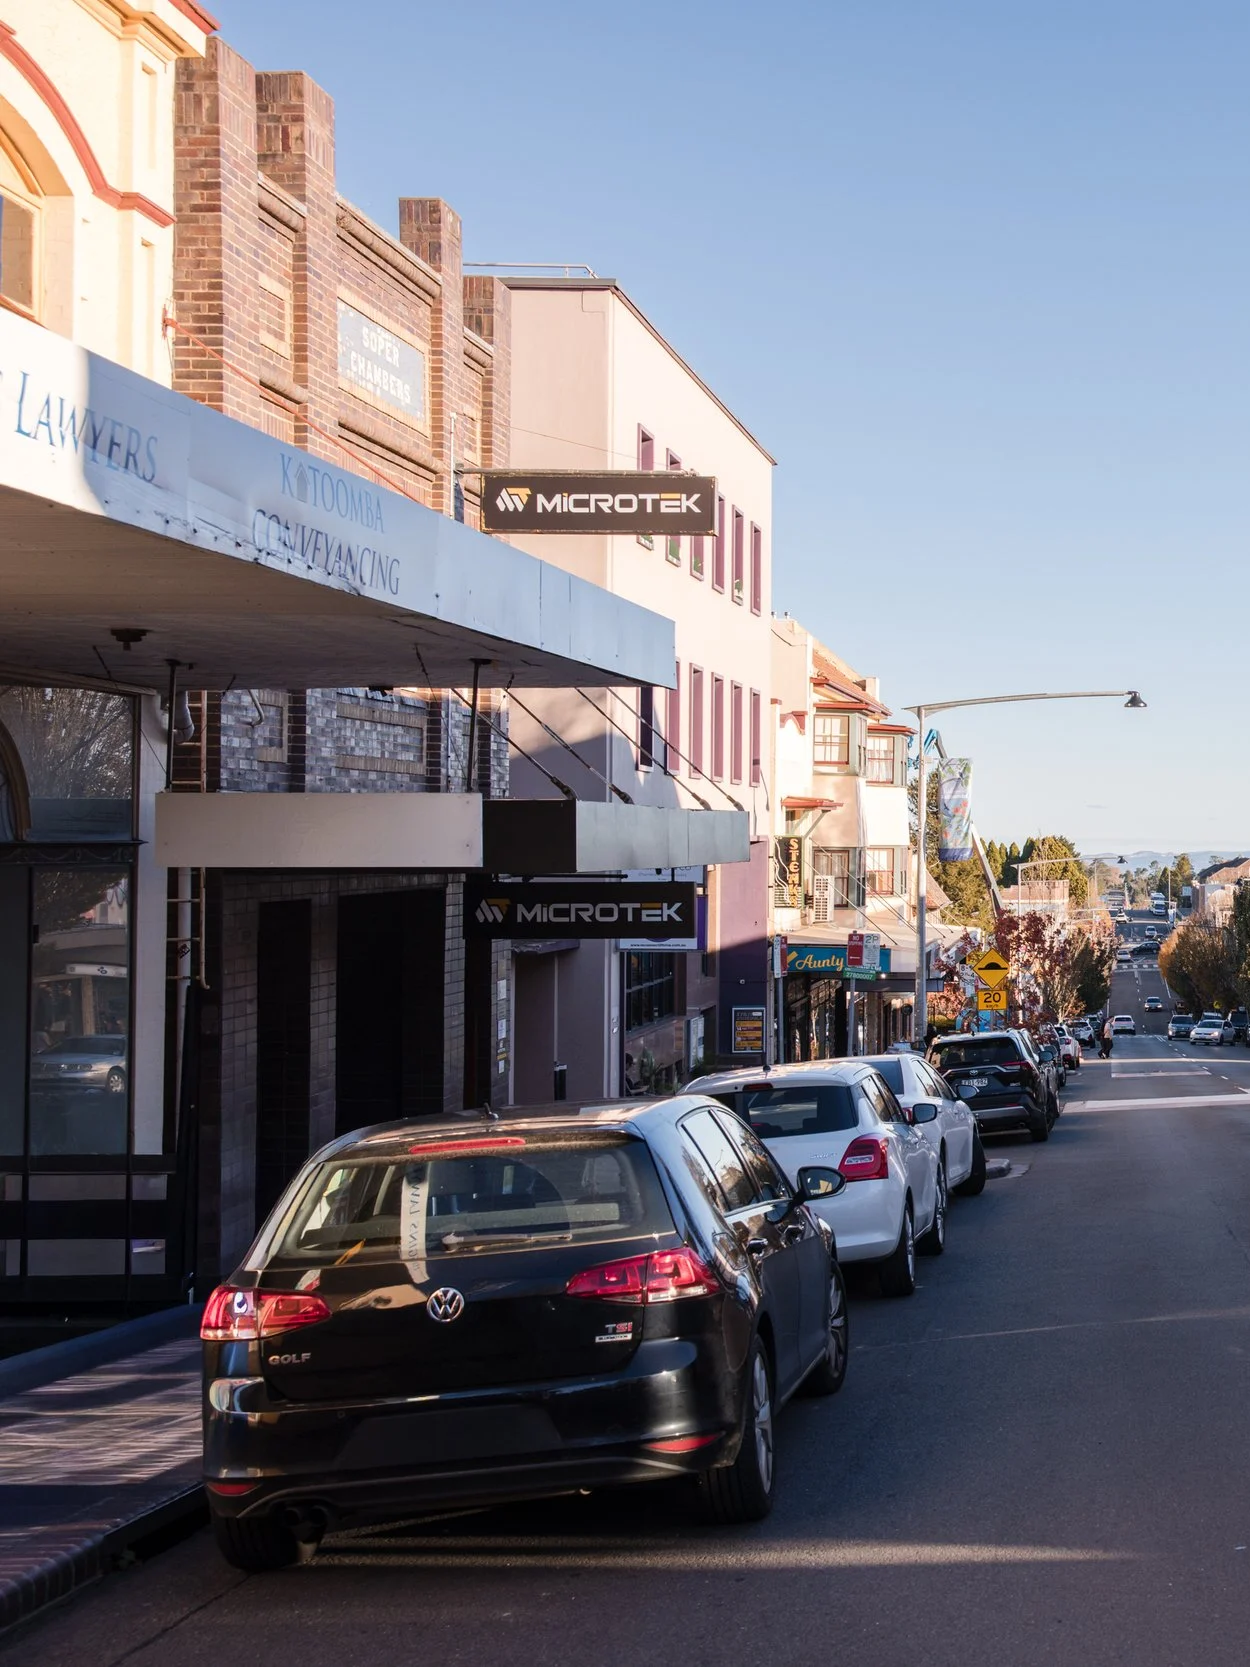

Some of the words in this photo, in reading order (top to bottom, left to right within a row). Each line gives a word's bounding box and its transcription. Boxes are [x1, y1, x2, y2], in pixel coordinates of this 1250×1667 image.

[362, 326, 400, 368] SOPER
[350, 350, 412, 404] CHAMBERS
[14, 370, 158, 483] LAWYERS
[253, 508, 401, 595] CONVEYANCING
[865, 936, 879, 944] 2P
[795, 954, 844, 972] Aunty
[983, 992, 1001, 1003] 20
[605, 1321, 633, 1334] TSI
[268, 1352, 312, 1366] GOLF
